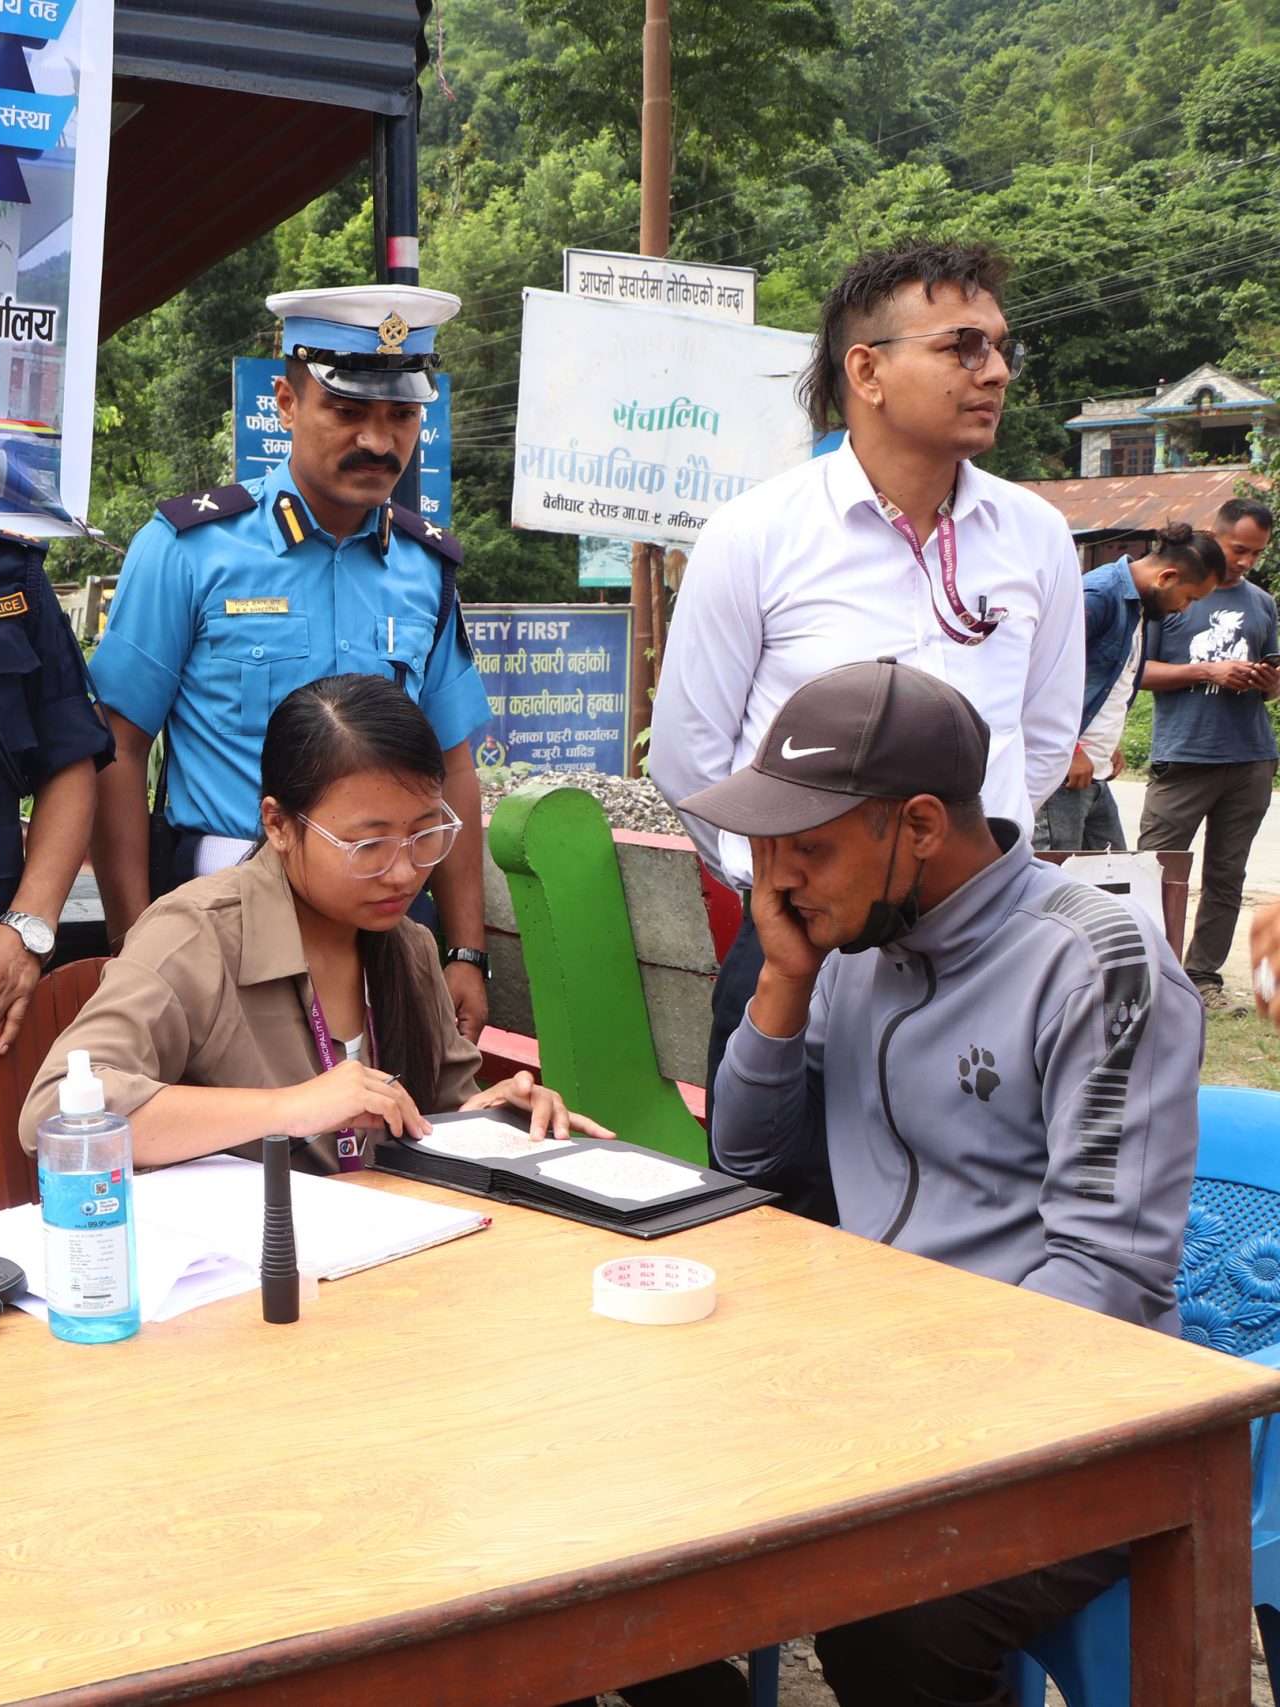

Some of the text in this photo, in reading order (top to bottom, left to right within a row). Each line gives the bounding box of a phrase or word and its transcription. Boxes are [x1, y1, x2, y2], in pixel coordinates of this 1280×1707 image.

[29, 0, 60, 22] तह
[619, 270, 663, 301] सवारीमा
[667, 273, 714, 306] तोकिएको
[613, 397, 720, 436] संचालित
[543, 491, 585, 514] बेनीघाट
[517, 622, 570, 641] FIRST
[504, 647, 527, 675] गरी
[530, 647, 564, 675] सवारी
[547, 728, 572, 744] प्रहरी
[575, 727, 619, 741] कार्यालय
